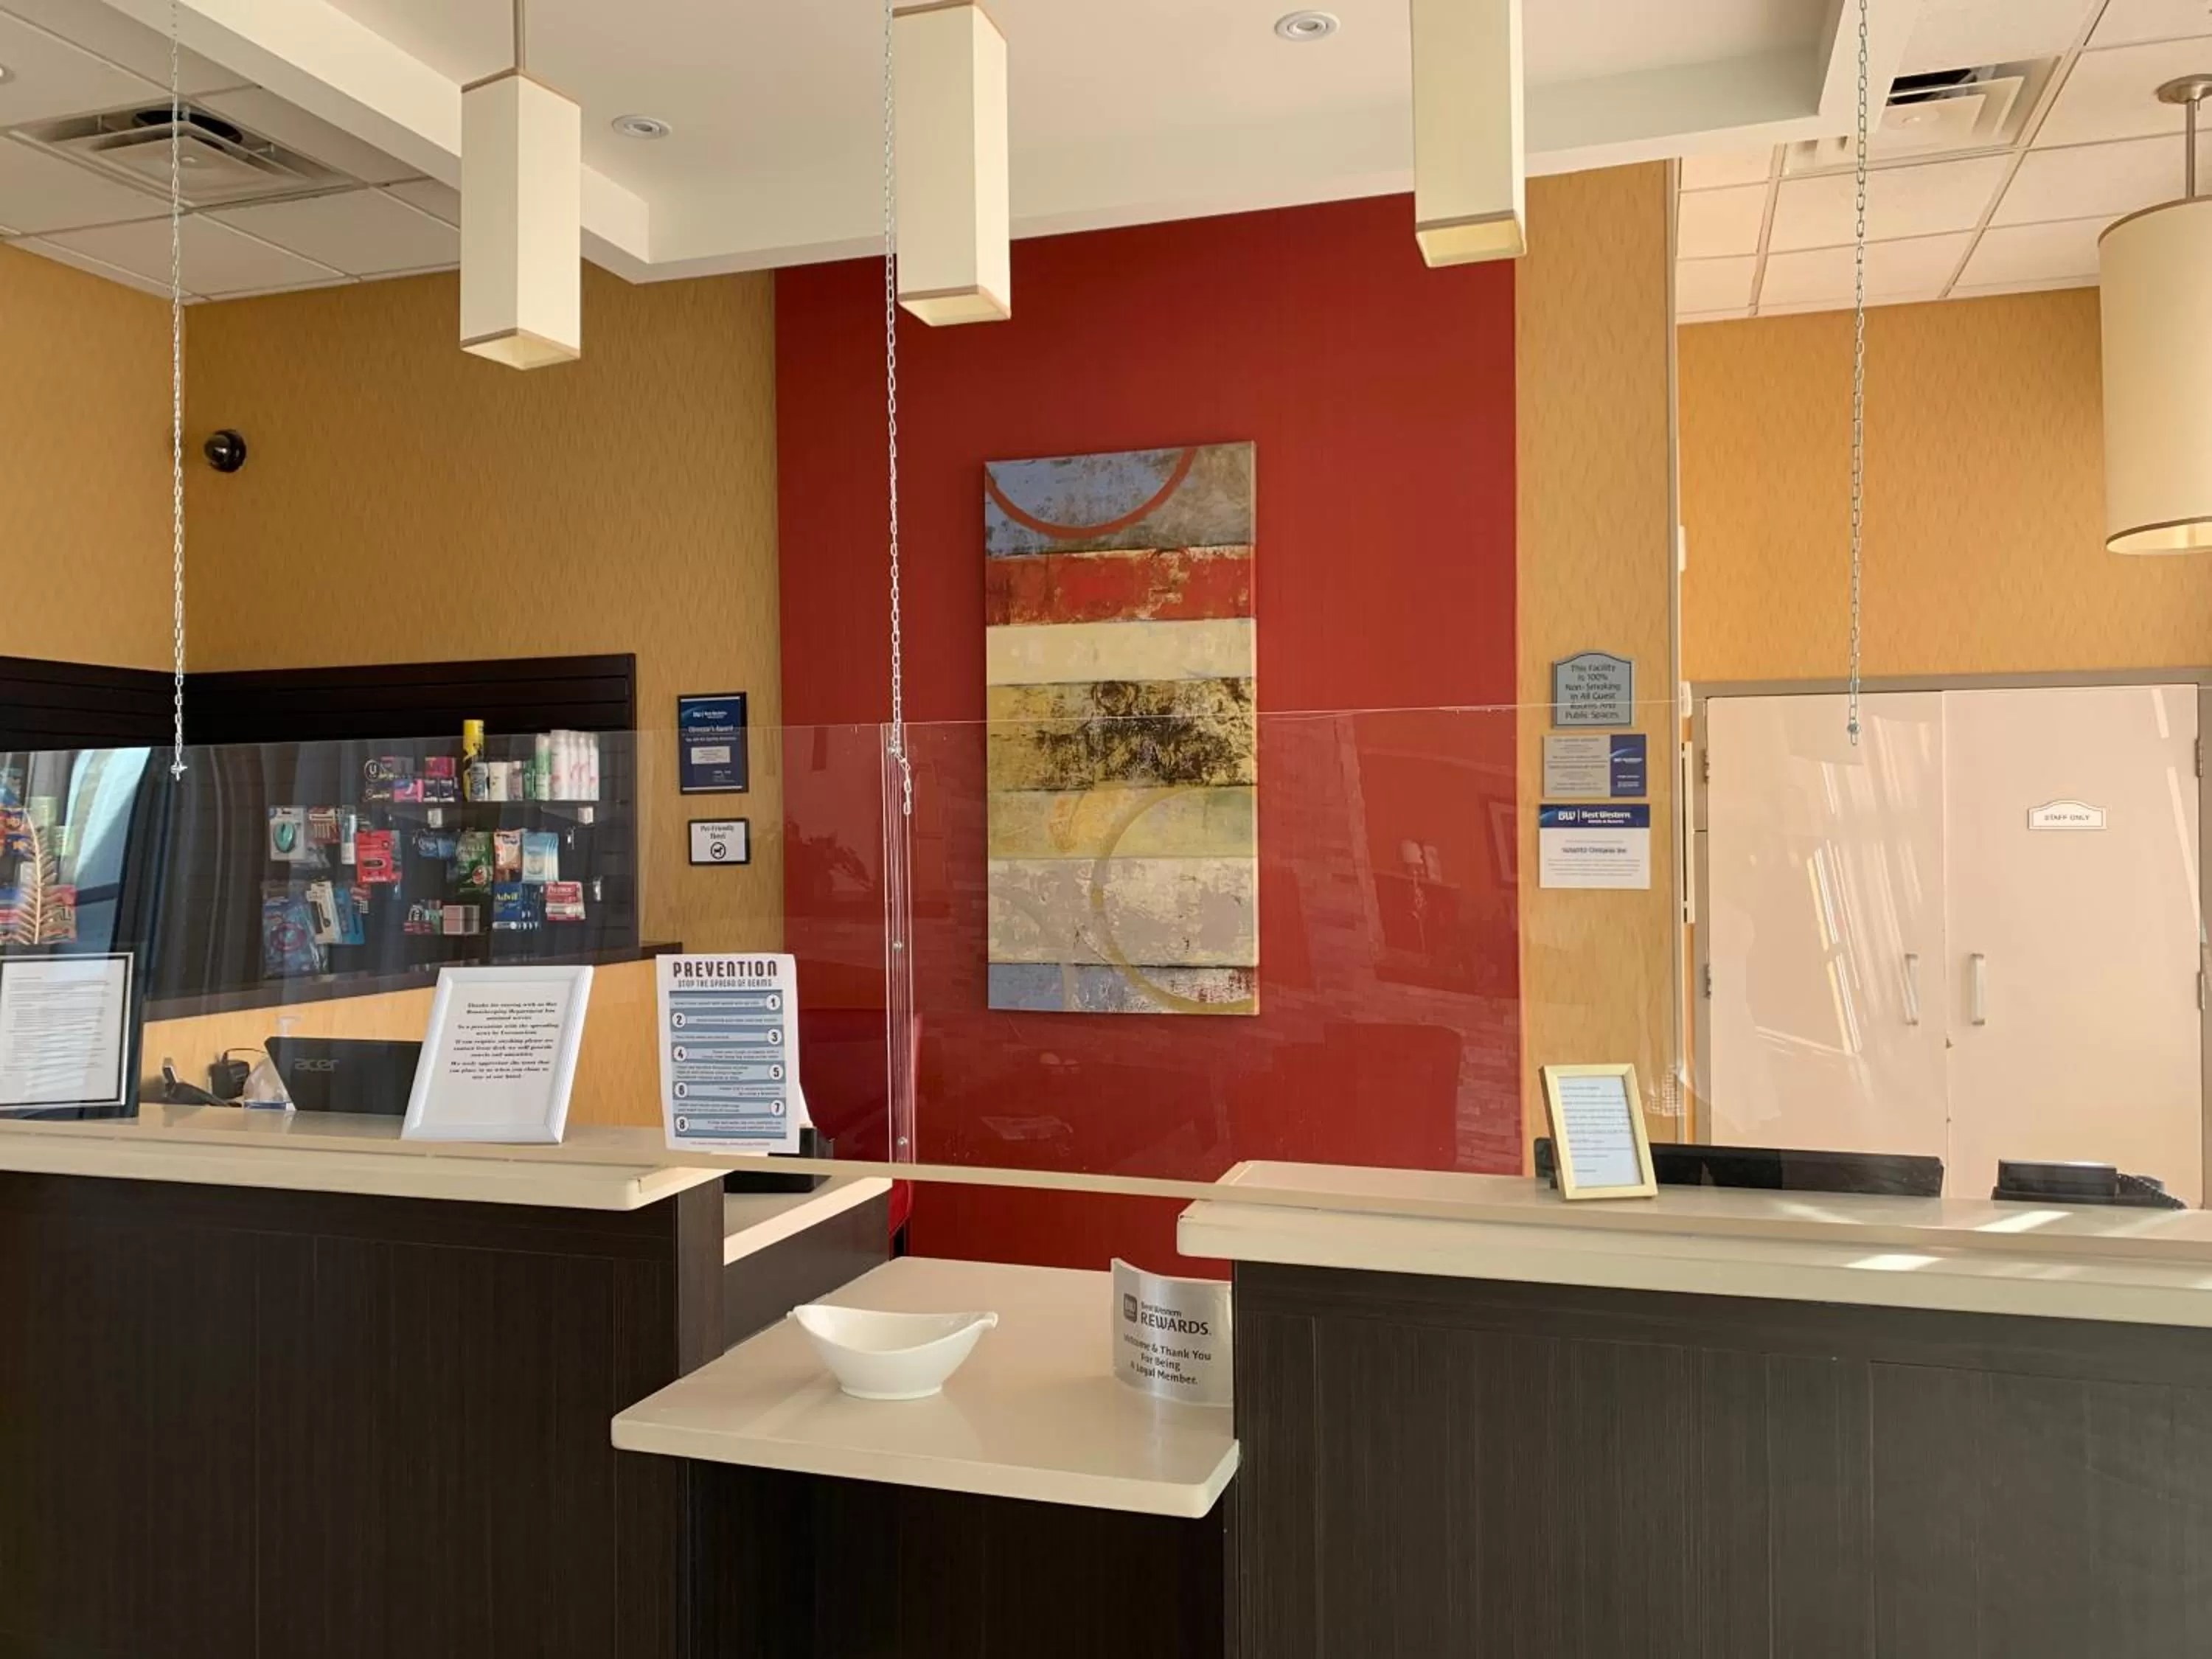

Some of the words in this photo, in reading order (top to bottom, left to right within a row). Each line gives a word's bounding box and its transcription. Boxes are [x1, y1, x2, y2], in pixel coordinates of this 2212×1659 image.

[1582, 811, 1600, 819] Best
[1600, 811, 1631, 820] Western
[496, 892, 519, 901] Advil
[672, 960, 777, 978] PREVENTION
[678, 979, 695, 988] STOP
[697, 979, 708, 987] THE
[711, 979, 736, 987] SPREAD
[676, 1015, 682, 1025] 2
[771, 1032, 778, 1042] 3
[677, 1048, 684, 1058] 4
[295, 1059, 339, 1073] acer
[773, 1067, 779, 1077] 5
[678, 1085, 684, 1095] 6
[774, 1104, 780, 1113] 7
[678, 1119, 685, 1130] 8
[1141, 1311, 1209, 1336] REWARDS
[1152, 1343, 1158, 1354] &
[1160, 1346, 1190, 1360] Thank
[1192, 1350, 1211, 1361] You
[1141, 1354, 1153, 1364] For
[1155, 1357, 1180, 1371] Being
[1136, 1363, 1155, 1379] Loyal
